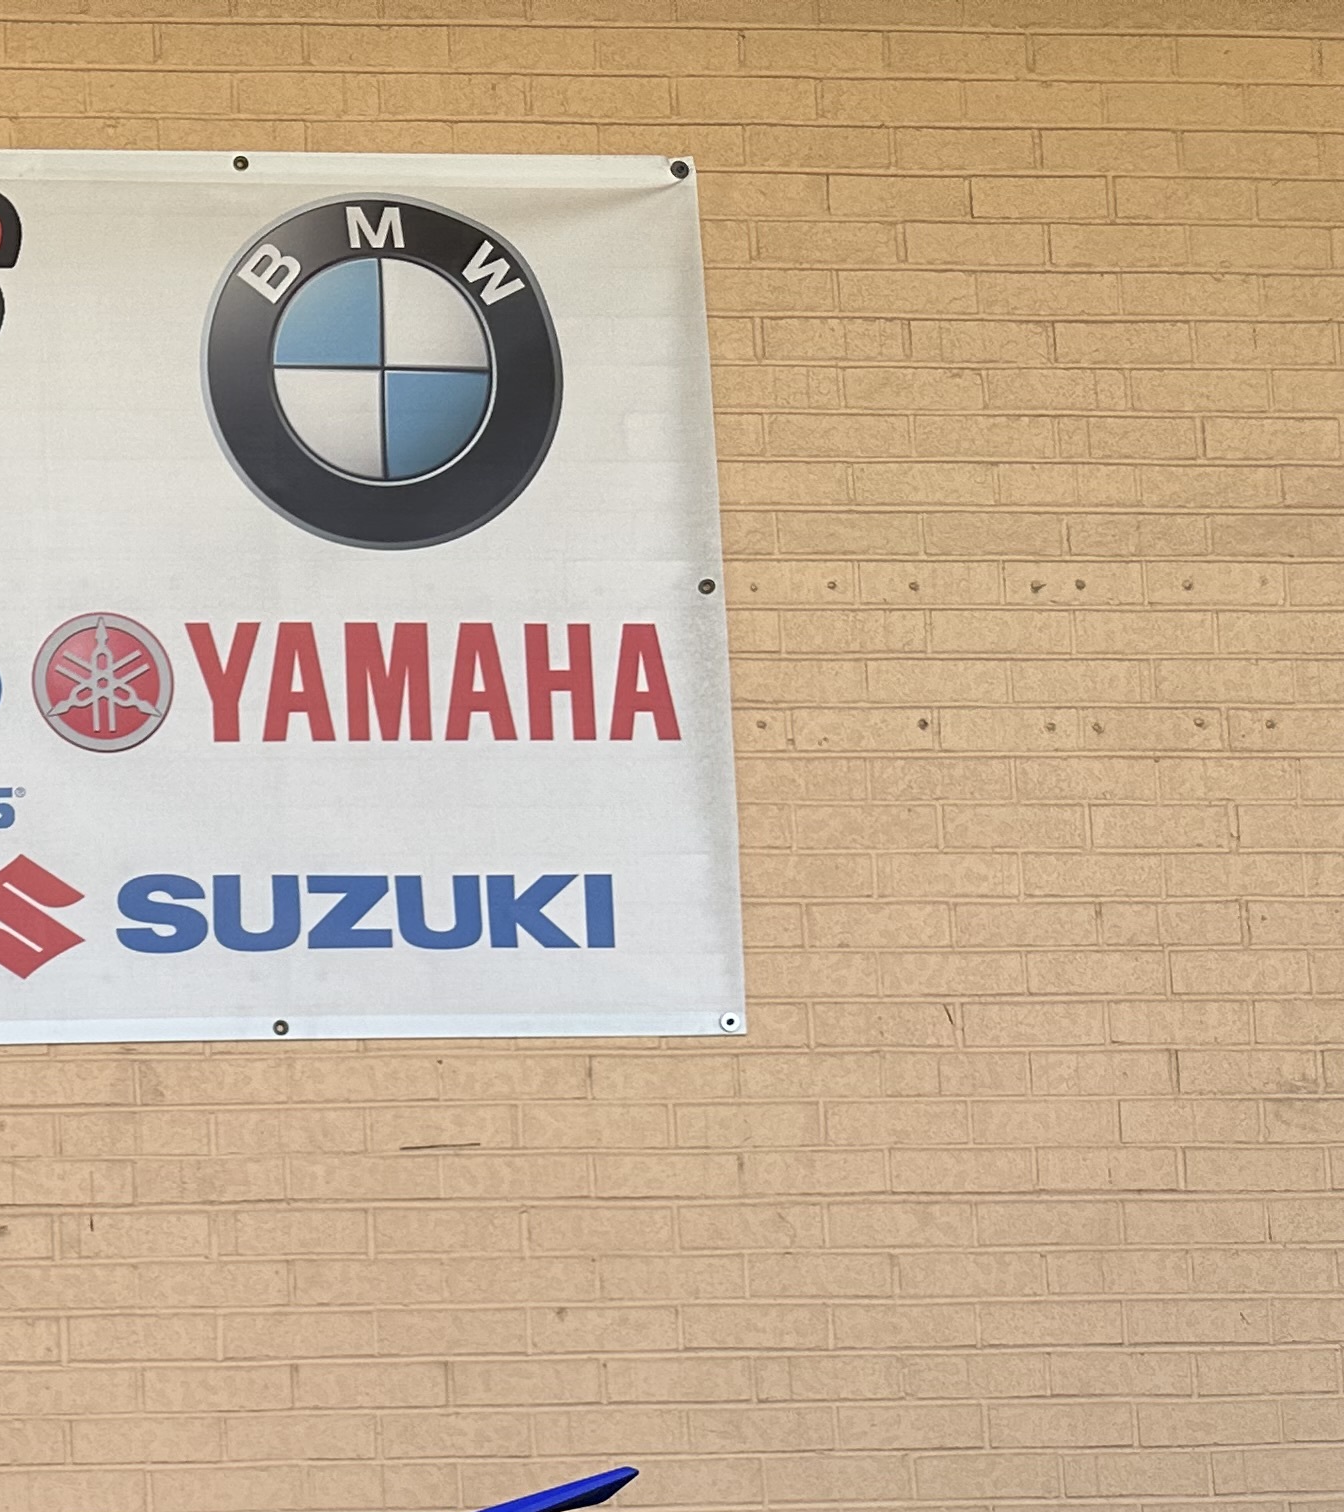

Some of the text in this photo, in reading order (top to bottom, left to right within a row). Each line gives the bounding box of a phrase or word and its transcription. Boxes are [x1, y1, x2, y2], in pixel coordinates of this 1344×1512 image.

[237, 206, 525, 305] BMW
[184, 622, 681, 743] YAMAHA
[115, 873, 616, 953] SUZUKI
